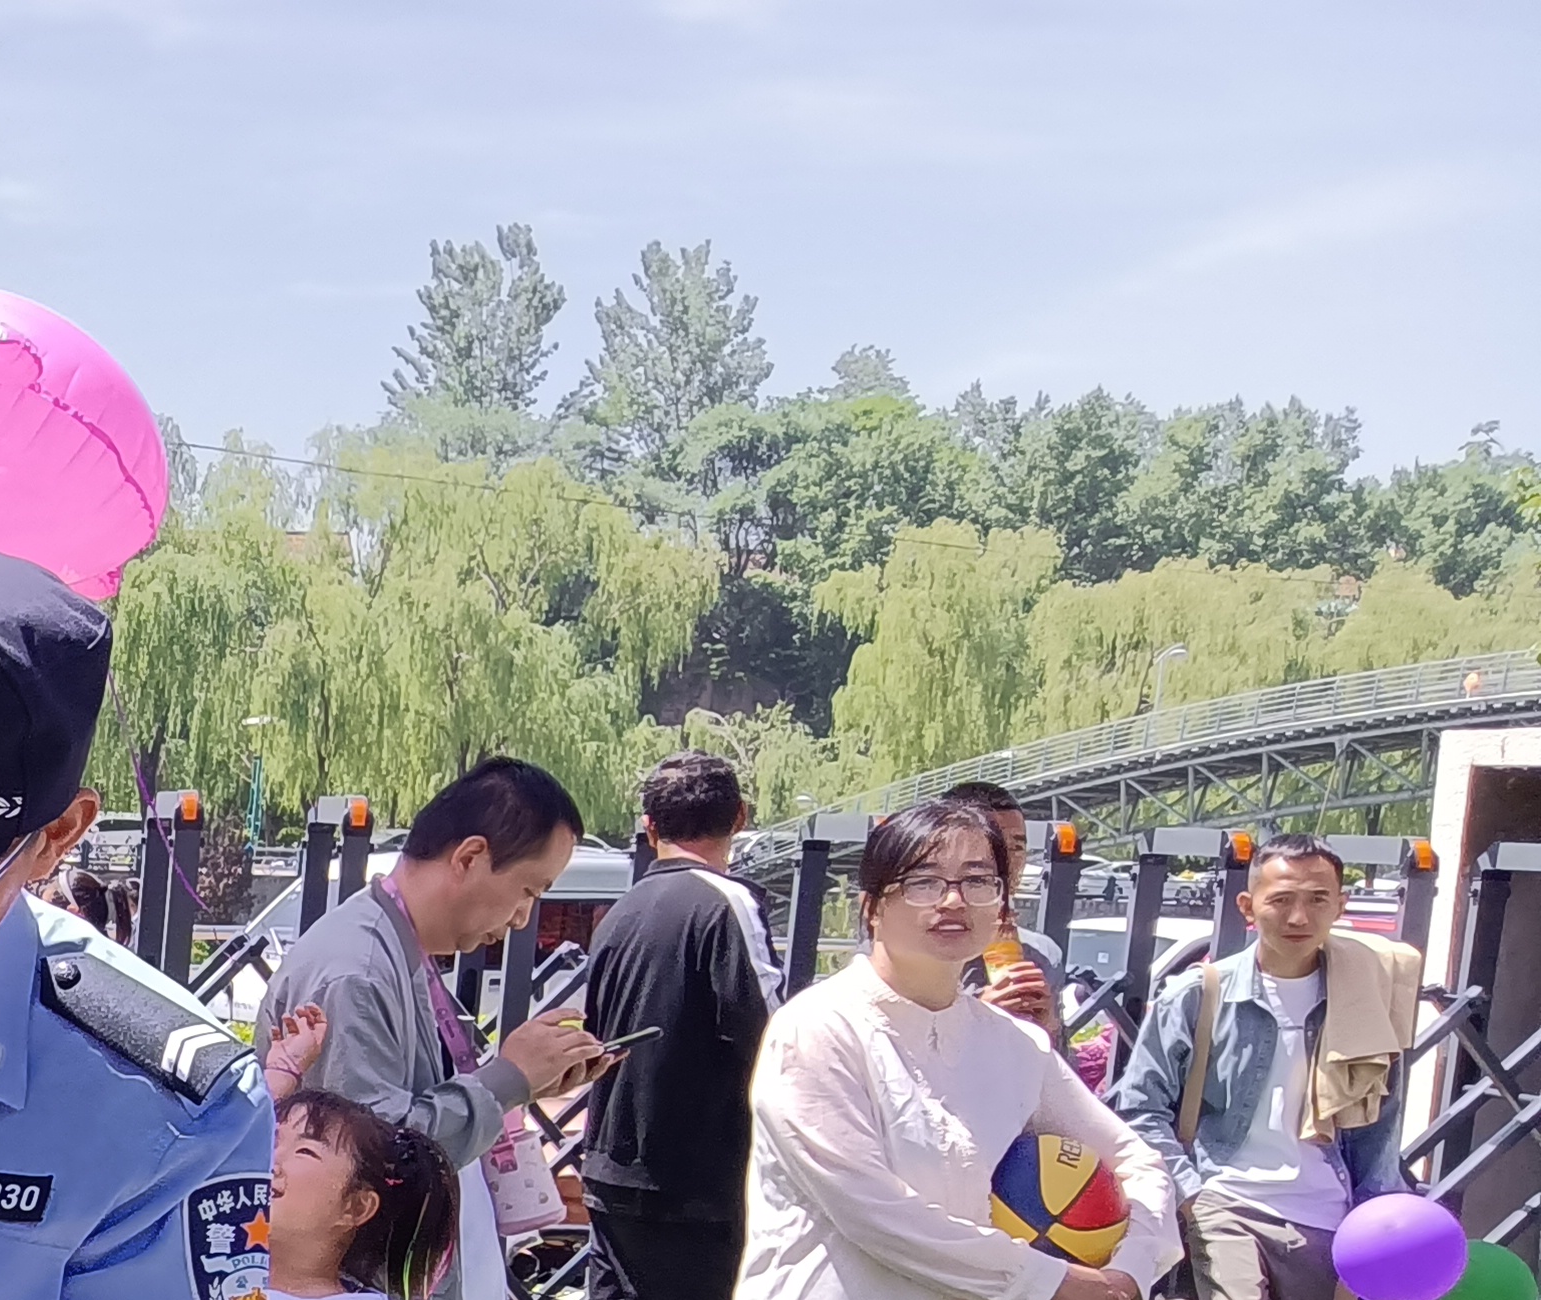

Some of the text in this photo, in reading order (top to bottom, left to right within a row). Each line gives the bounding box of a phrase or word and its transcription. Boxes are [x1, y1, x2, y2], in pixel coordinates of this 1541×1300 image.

[1056, 1138, 1082, 1169] RE
[197, 1183, 270, 1222] 中华人民
